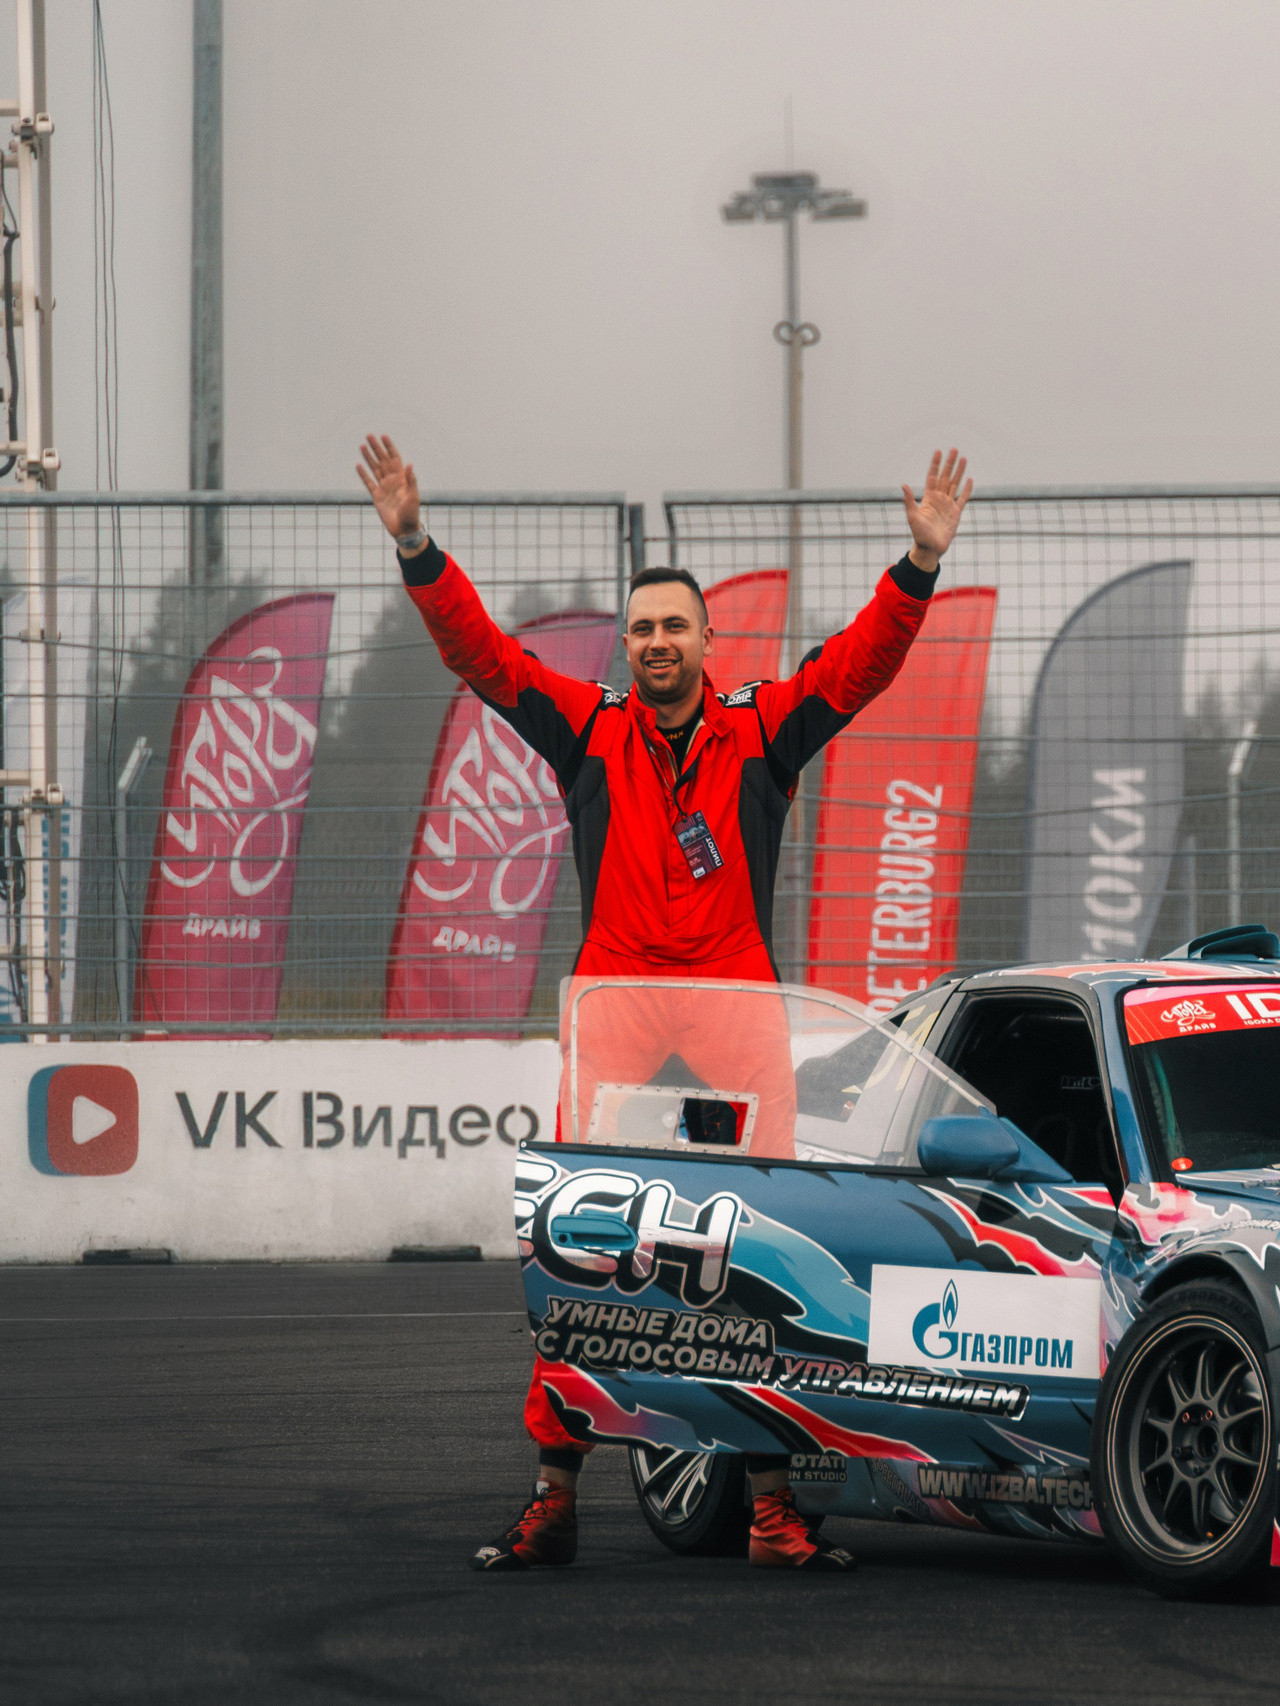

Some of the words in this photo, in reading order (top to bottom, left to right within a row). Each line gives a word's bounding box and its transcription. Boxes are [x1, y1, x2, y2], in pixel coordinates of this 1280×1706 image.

[705, 837, 722, 867] ПИЛОТ
[183, 914, 261, 940] ДРАЙВ
[1179, 1023, 1216, 1033] ДРАЙВ
[1244, 1018, 1274, 1026] IGORA
[175, 1090, 283, 1148] VK
[302, 1090, 541, 1158] Видео
[547, 1300, 669, 1336] УМНЫЕ
[670, 1315, 768, 1349] ДОМА
[960, 1332, 1073, 1369] ГАЗПРОМ
[537, 1330, 560, 1354] С
[564, 1334, 776, 1378] ГОЛОСОВЫМ
[779, 1360, 1022, 1411] УПРАВЛЕНИЕМ
[804, 1471, 846, 1482] STUDIO
